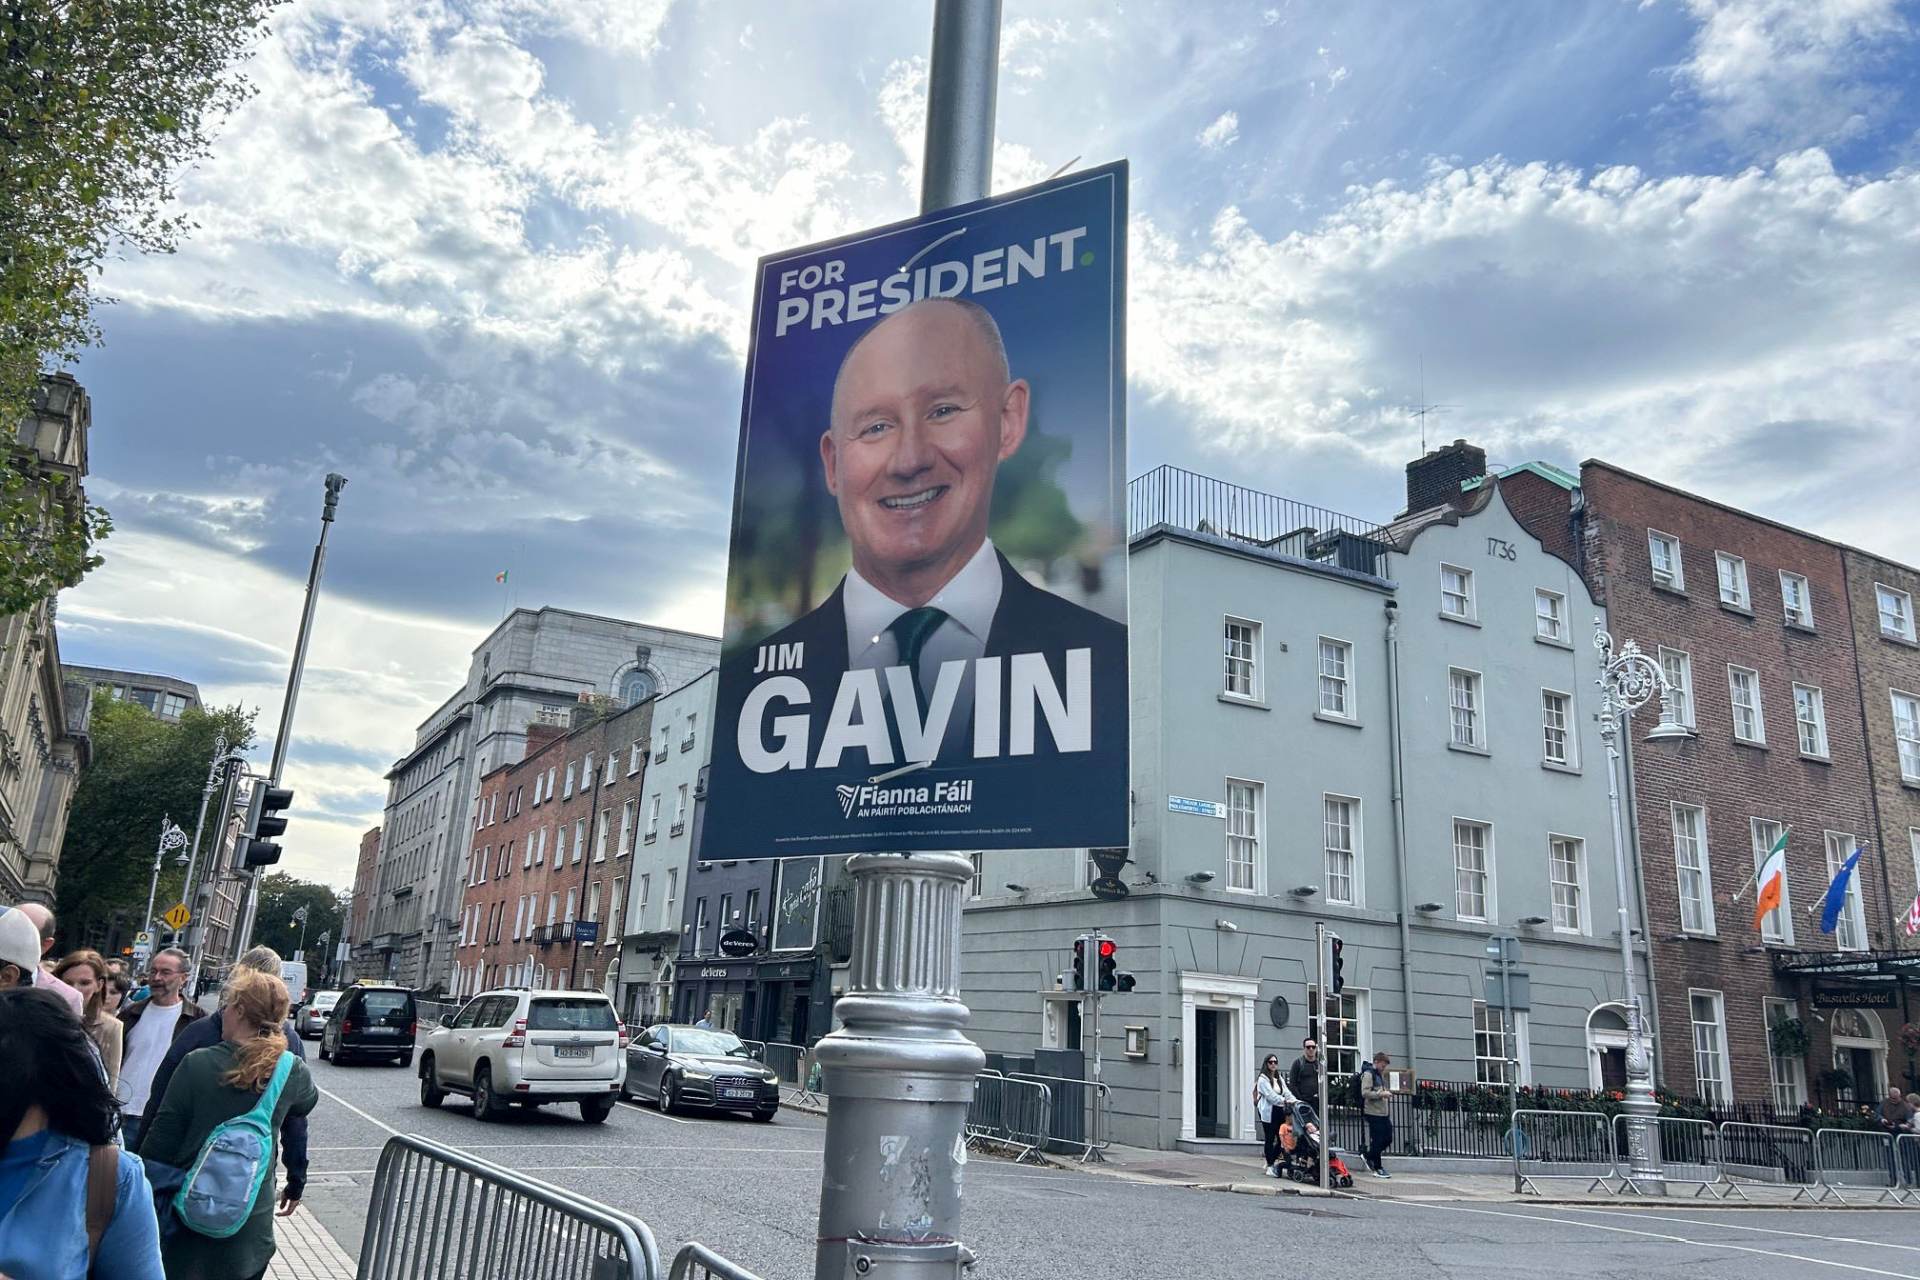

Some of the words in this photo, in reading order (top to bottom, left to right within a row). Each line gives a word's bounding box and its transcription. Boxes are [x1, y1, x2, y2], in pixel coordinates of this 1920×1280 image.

[779, 260, 846, 295] FOR
[1487, 537, 1517, 561] 1736
[753, 642, 804, 674] JIM
[737, 647, 1092, 774] GAVIN
[859, 785, 929, 806] Fianna
[934, 780, 973, 801] Fáil
[857, 808, 870, 817] AN
[870, 804, 897, 816] PÁIRTÍ
[897, 803, 972, 815] POBLACHTÁNACH
